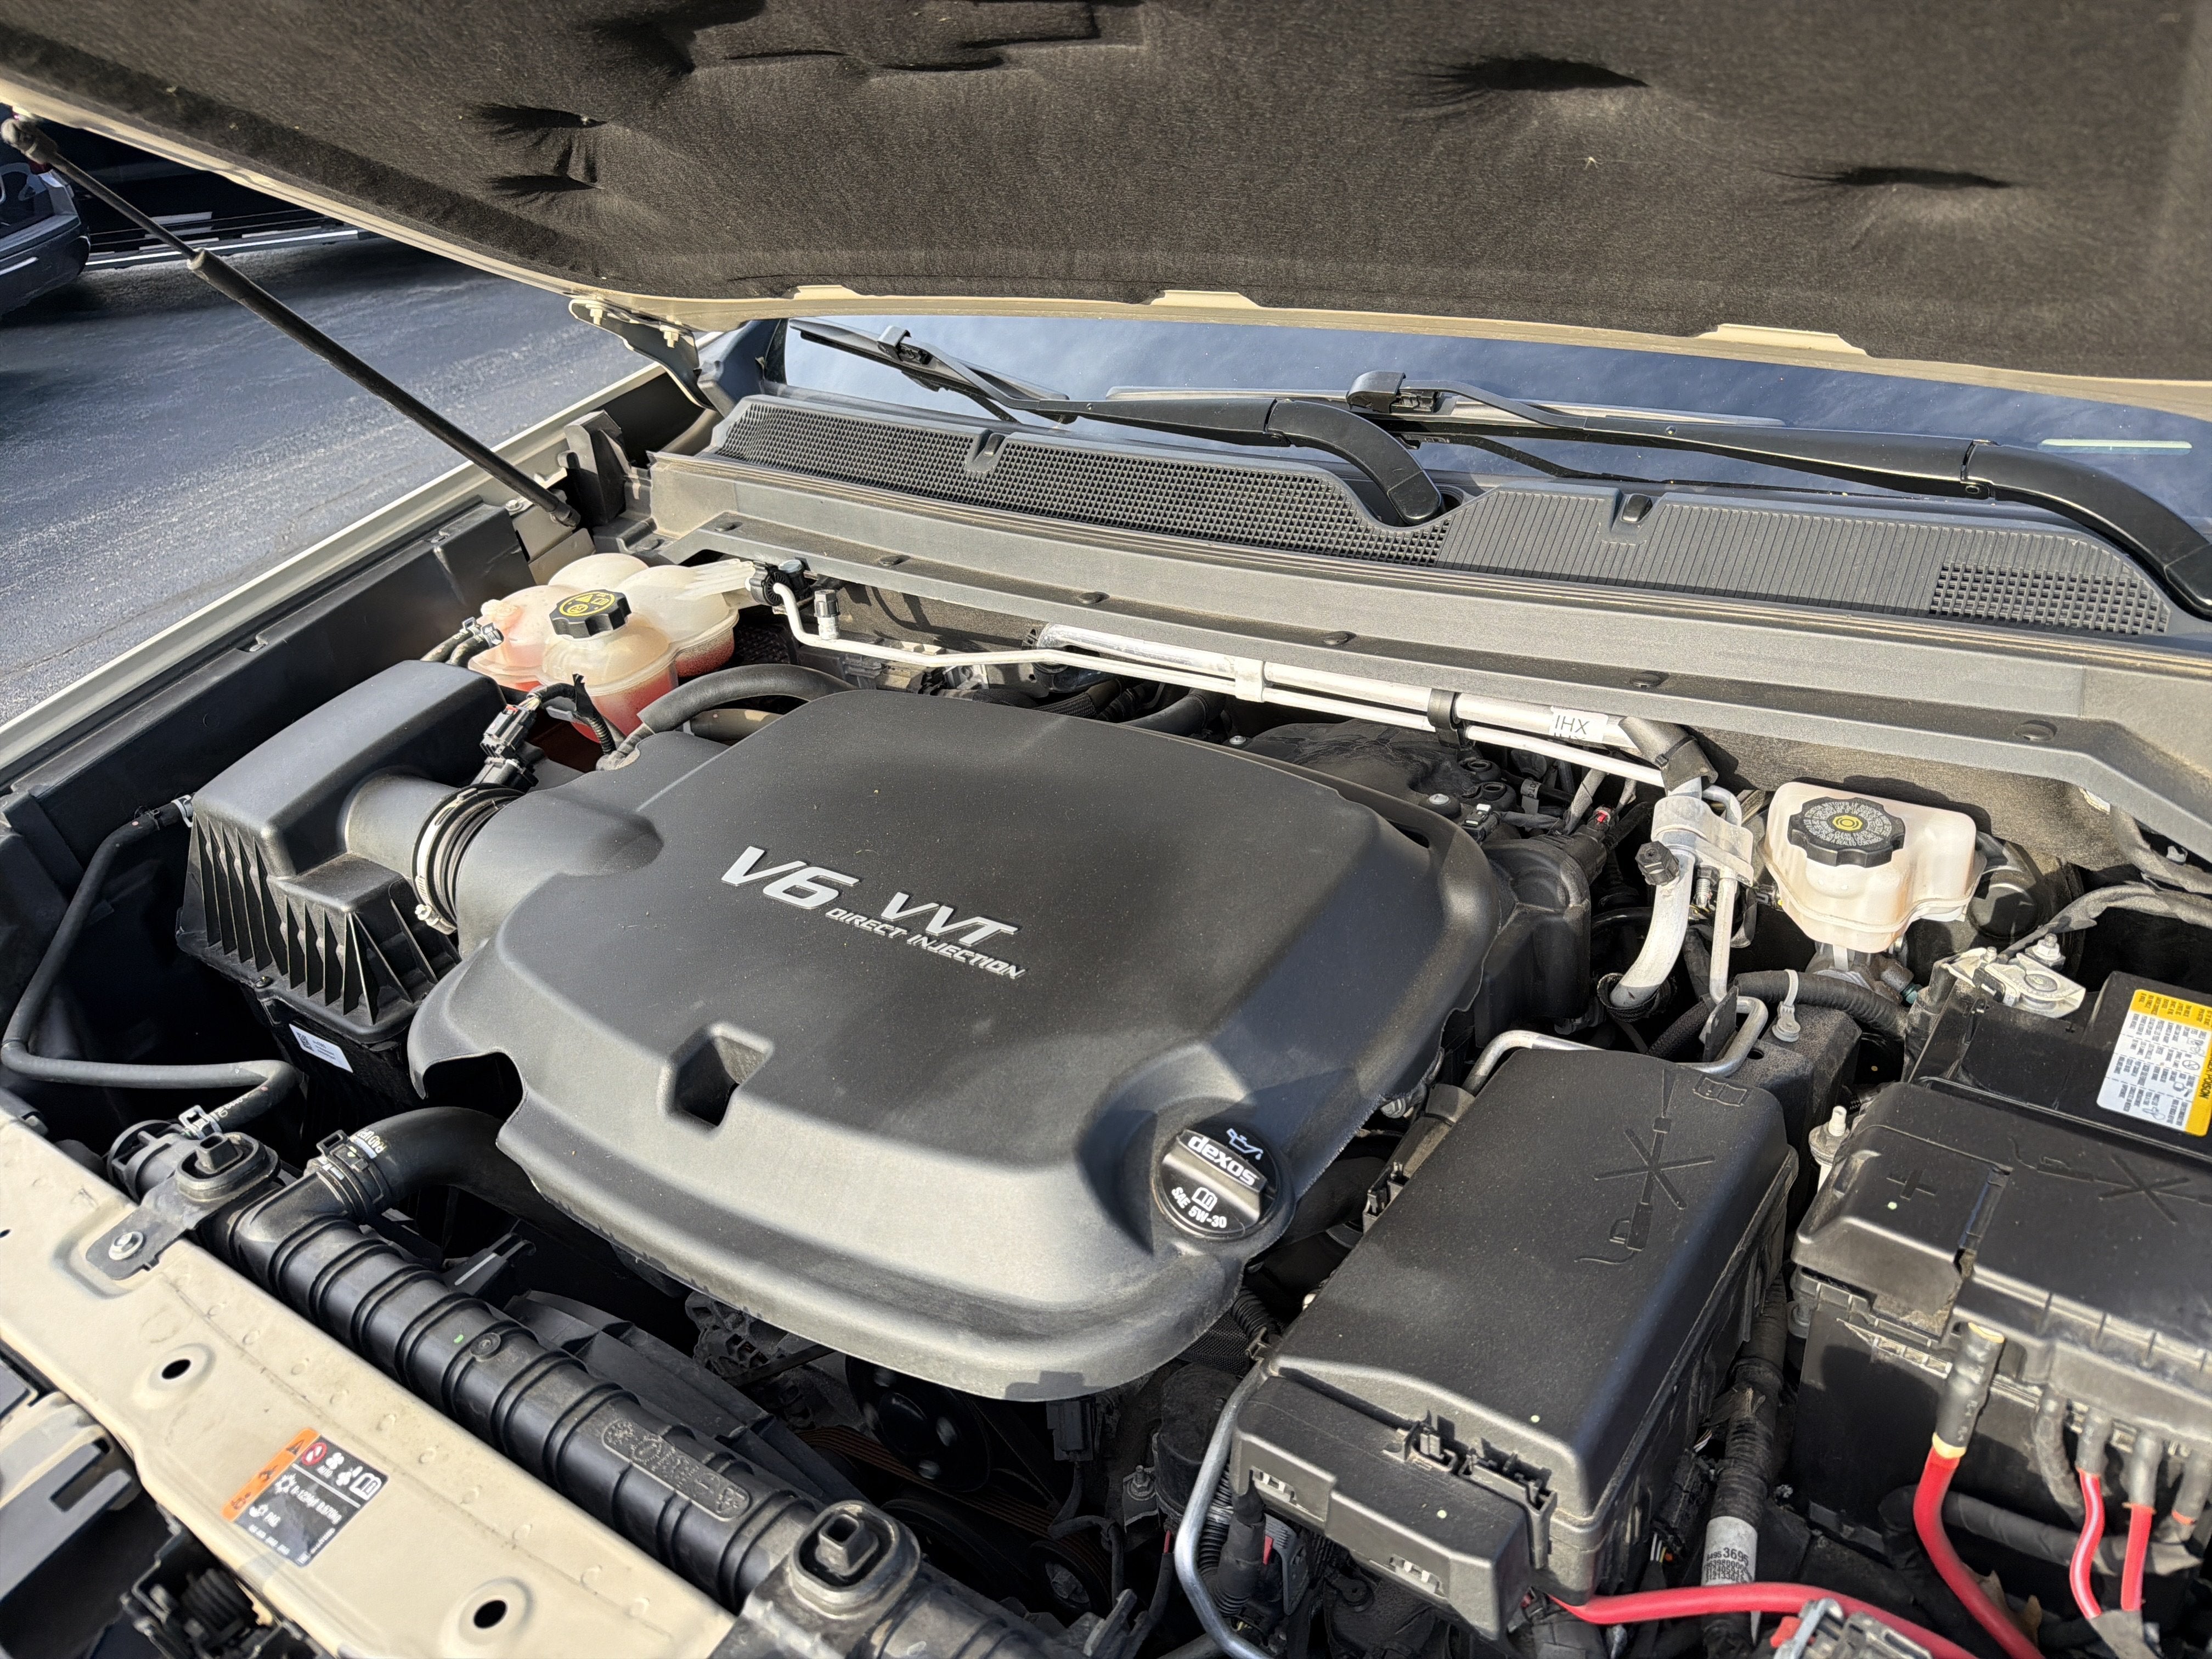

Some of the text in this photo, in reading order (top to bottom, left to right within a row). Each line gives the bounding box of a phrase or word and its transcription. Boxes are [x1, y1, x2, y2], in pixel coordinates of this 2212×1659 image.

[1555, 715, 1590, 735] IHX
[721, 845, 1019, 947] V6 VVT
[825, 908, 1026, 979] DIRECT INJECTION
[1188, 1136, 1258, 1186] dexos
[1171, 1187, 1227, 1228] SAE 5W-30
